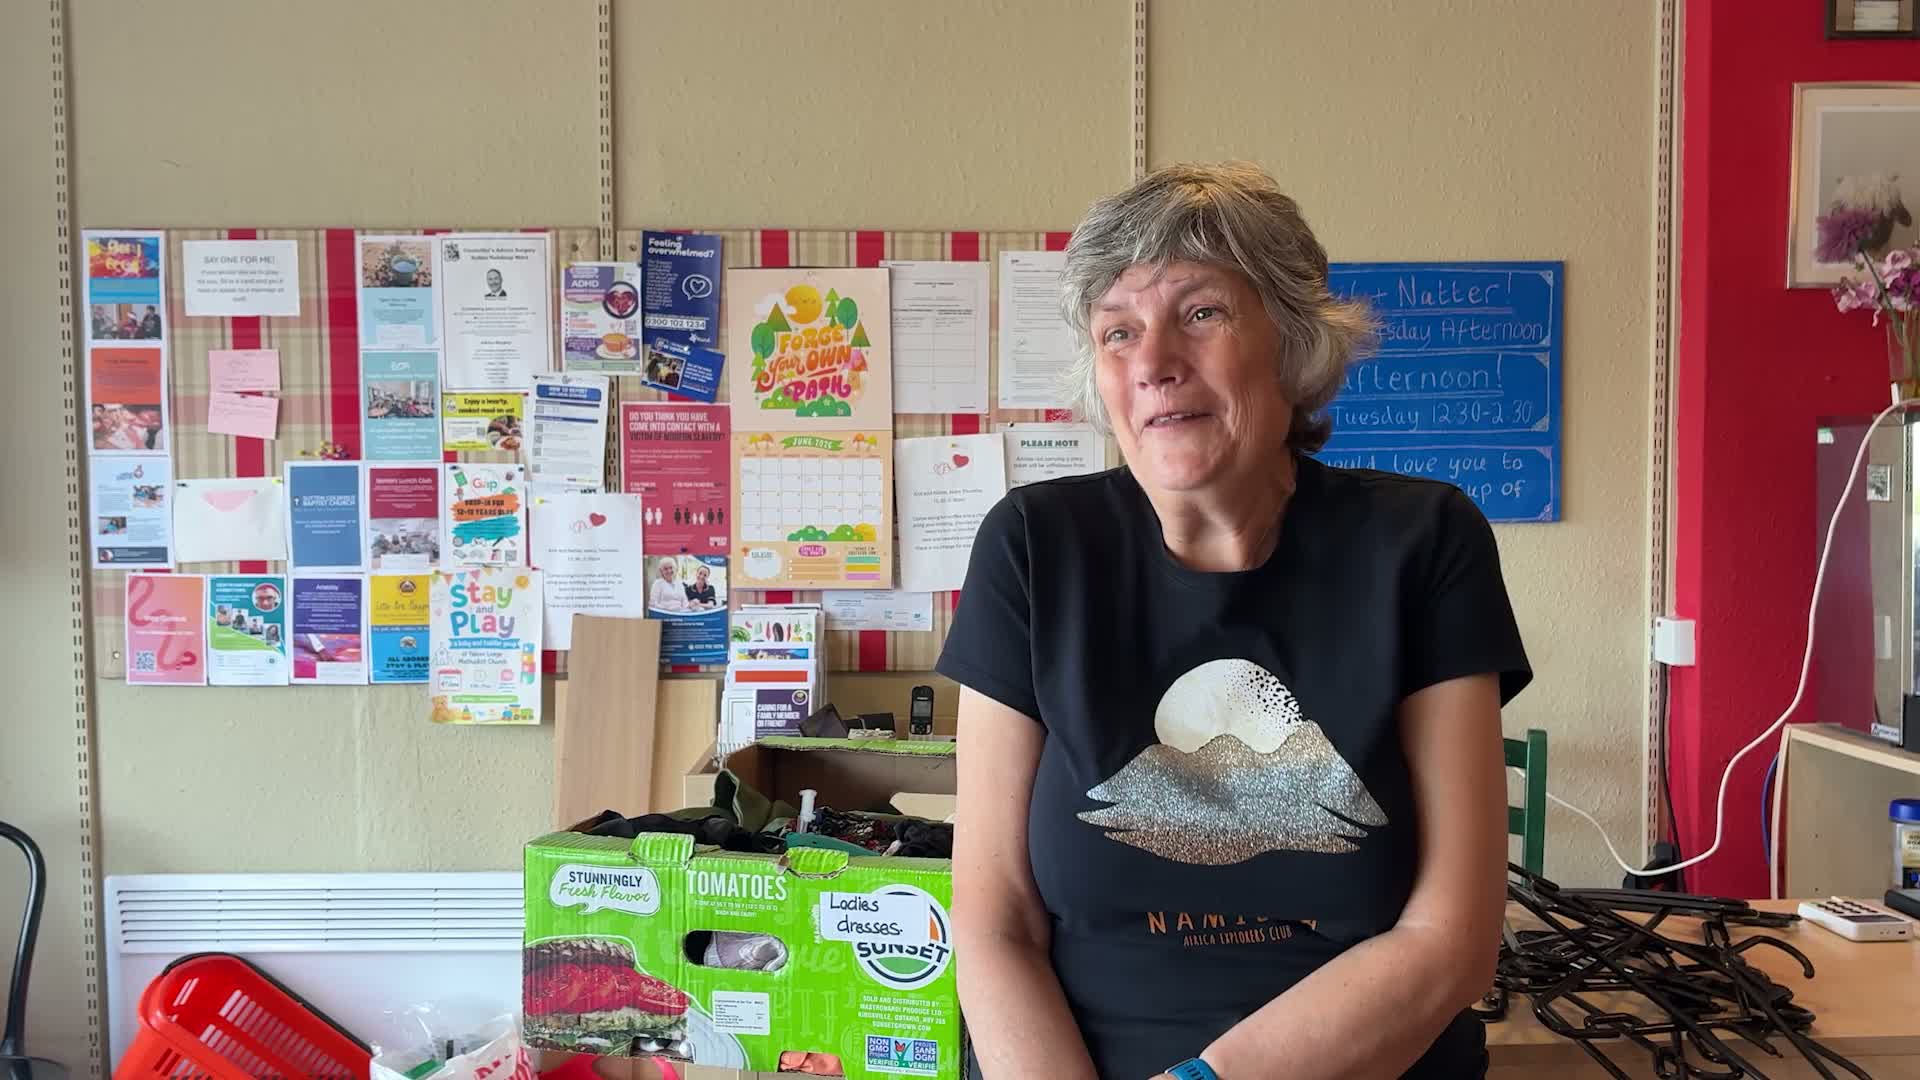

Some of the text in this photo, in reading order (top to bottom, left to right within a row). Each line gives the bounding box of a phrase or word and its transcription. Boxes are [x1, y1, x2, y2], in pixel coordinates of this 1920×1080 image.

[648, 237, 683, 250] Feeling
[648, 248, 715, 259] overwhelmed?
[203, 256, 276, 264] SAY ONE FOR ME!
[571, 279, 599, 288] ADHD
[1399, 272, 1512, 307] Natter!
[645, 318, 706, 329] 0300 102 1234
[1441, 319, 1543, 343] Afternoon
[779, 323, 845, 353] FORGE
[806, 344, 852, 371] OWN
[783, 374, 852, 402] PATH
[464, 398, 481, 406] Enjoy
[629, 411, 708, 421] DO YOU THINK YOU HAVE
[1335, 405, 1420, 433] Tuesday
[629, 422, 721, 432] COME INTO CONTACT WITH A
[793, 437, 814, 447] JUNE
[1020, 439, 1079, 447] PLEASE NOTE
[1393, 453, 1438, 475] love
[1449, 456, 1487, 480] you
[1502, 451, 1524, 470] to
[1456, 479, 1526, 505] up of
[449, 581, 513, 609] Stay
[475, 605, 494, 614] and
[449, 611, 515, 639] Play
[757, 703, 776, 711] CARING
[777, 703, 787, 711] FOR
[777, 712, 800, 720] MEMBER
[568, 871, 643, 888] STUNNINGLY
[687, 869, 788, 902] TOMATOES
[559, 883, 651, 903] Fresh Flavor
[830, 893, 880, 913] Ladies
[1183, 924, 1293, 948] AFRICA EXPLORERS CLUB
[863, 995, 878, 1003] SOLD
[892, 997, 931, 1007] DISTRIBUTED
[902, 1007, 930, 1015] PRODUCE
[868, 1037, 889, 1046] NON
[868, 1045, 890, 1053] GMO
[914, 1047, 936, 1055] SANS
[868, 1058, 900, 1067] VERIFIED
[914, 1054, 936, 1062] OGM
